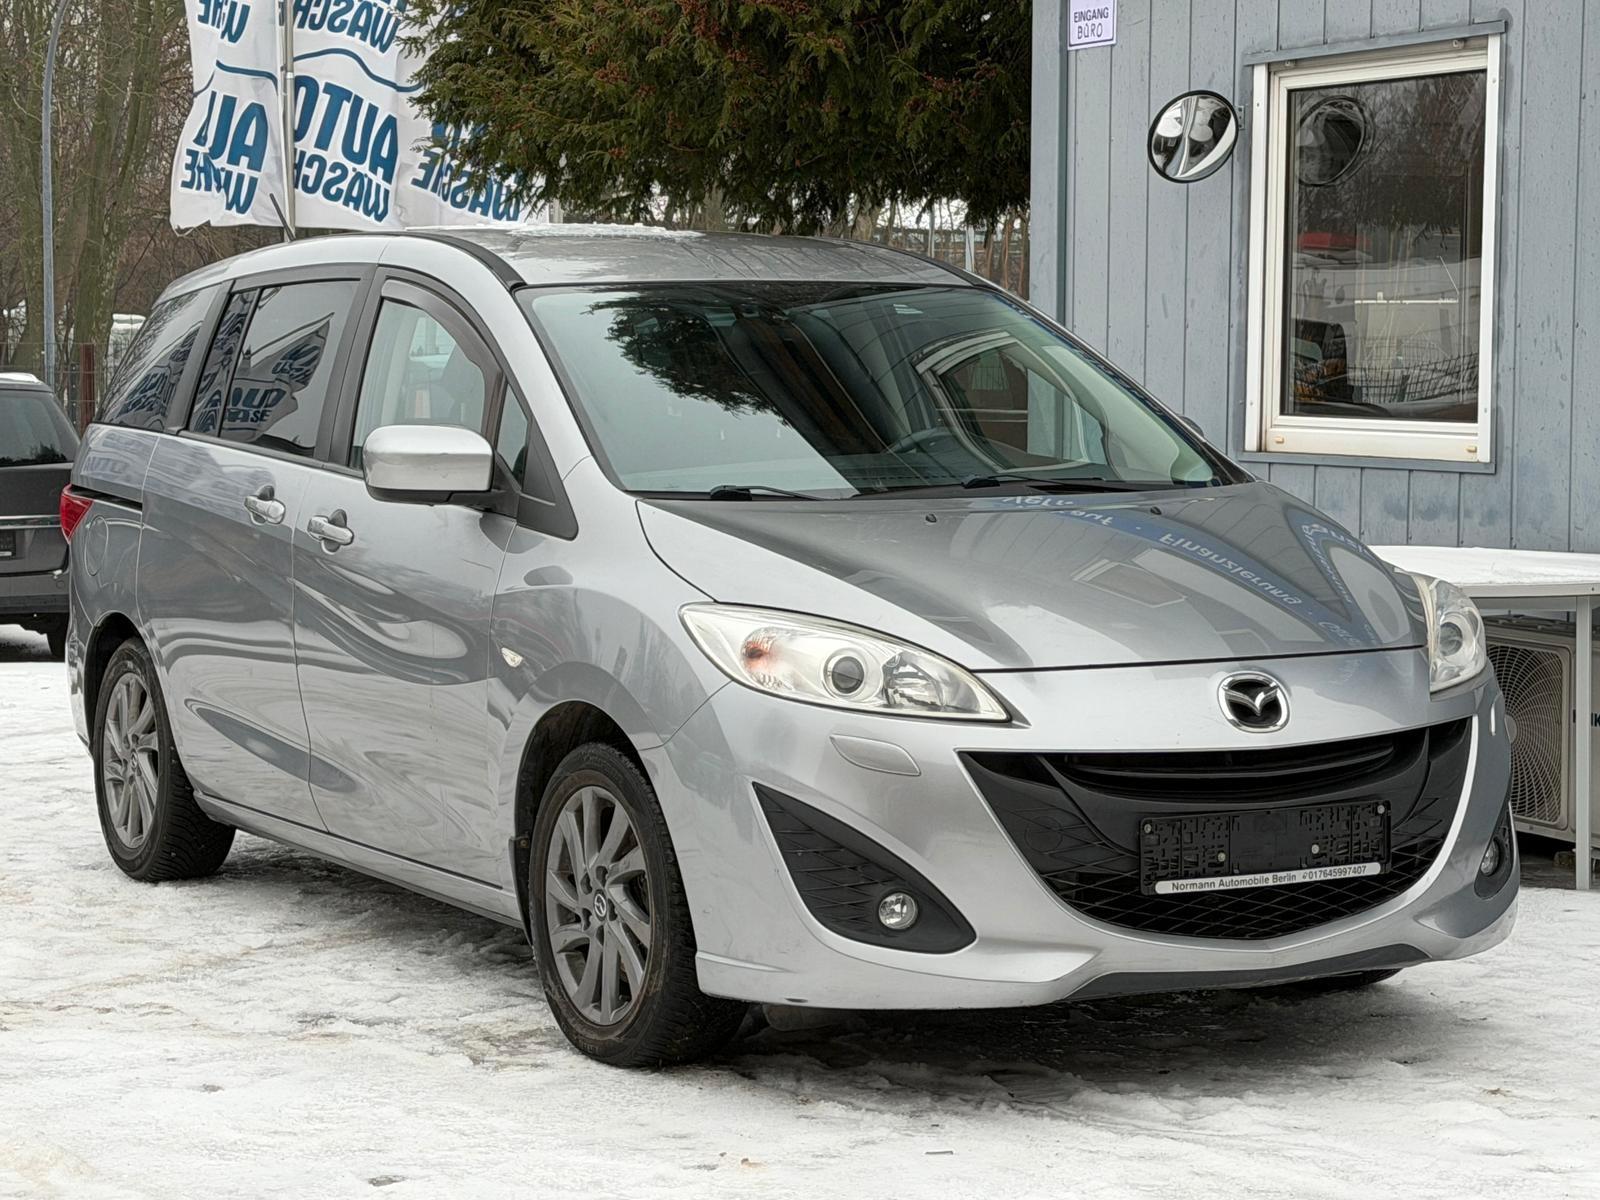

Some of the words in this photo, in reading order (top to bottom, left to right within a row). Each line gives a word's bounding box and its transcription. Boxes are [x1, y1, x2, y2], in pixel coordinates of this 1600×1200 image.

[1073, 7, 1109, 23] EINGANG
[1077, 23, 1103, 39] BÜRO
[1171, 879, 1216, 892] Normann
[1218, 875, 1270, 889] Automobile
[1271, 872, 1297, 884] Berlin
